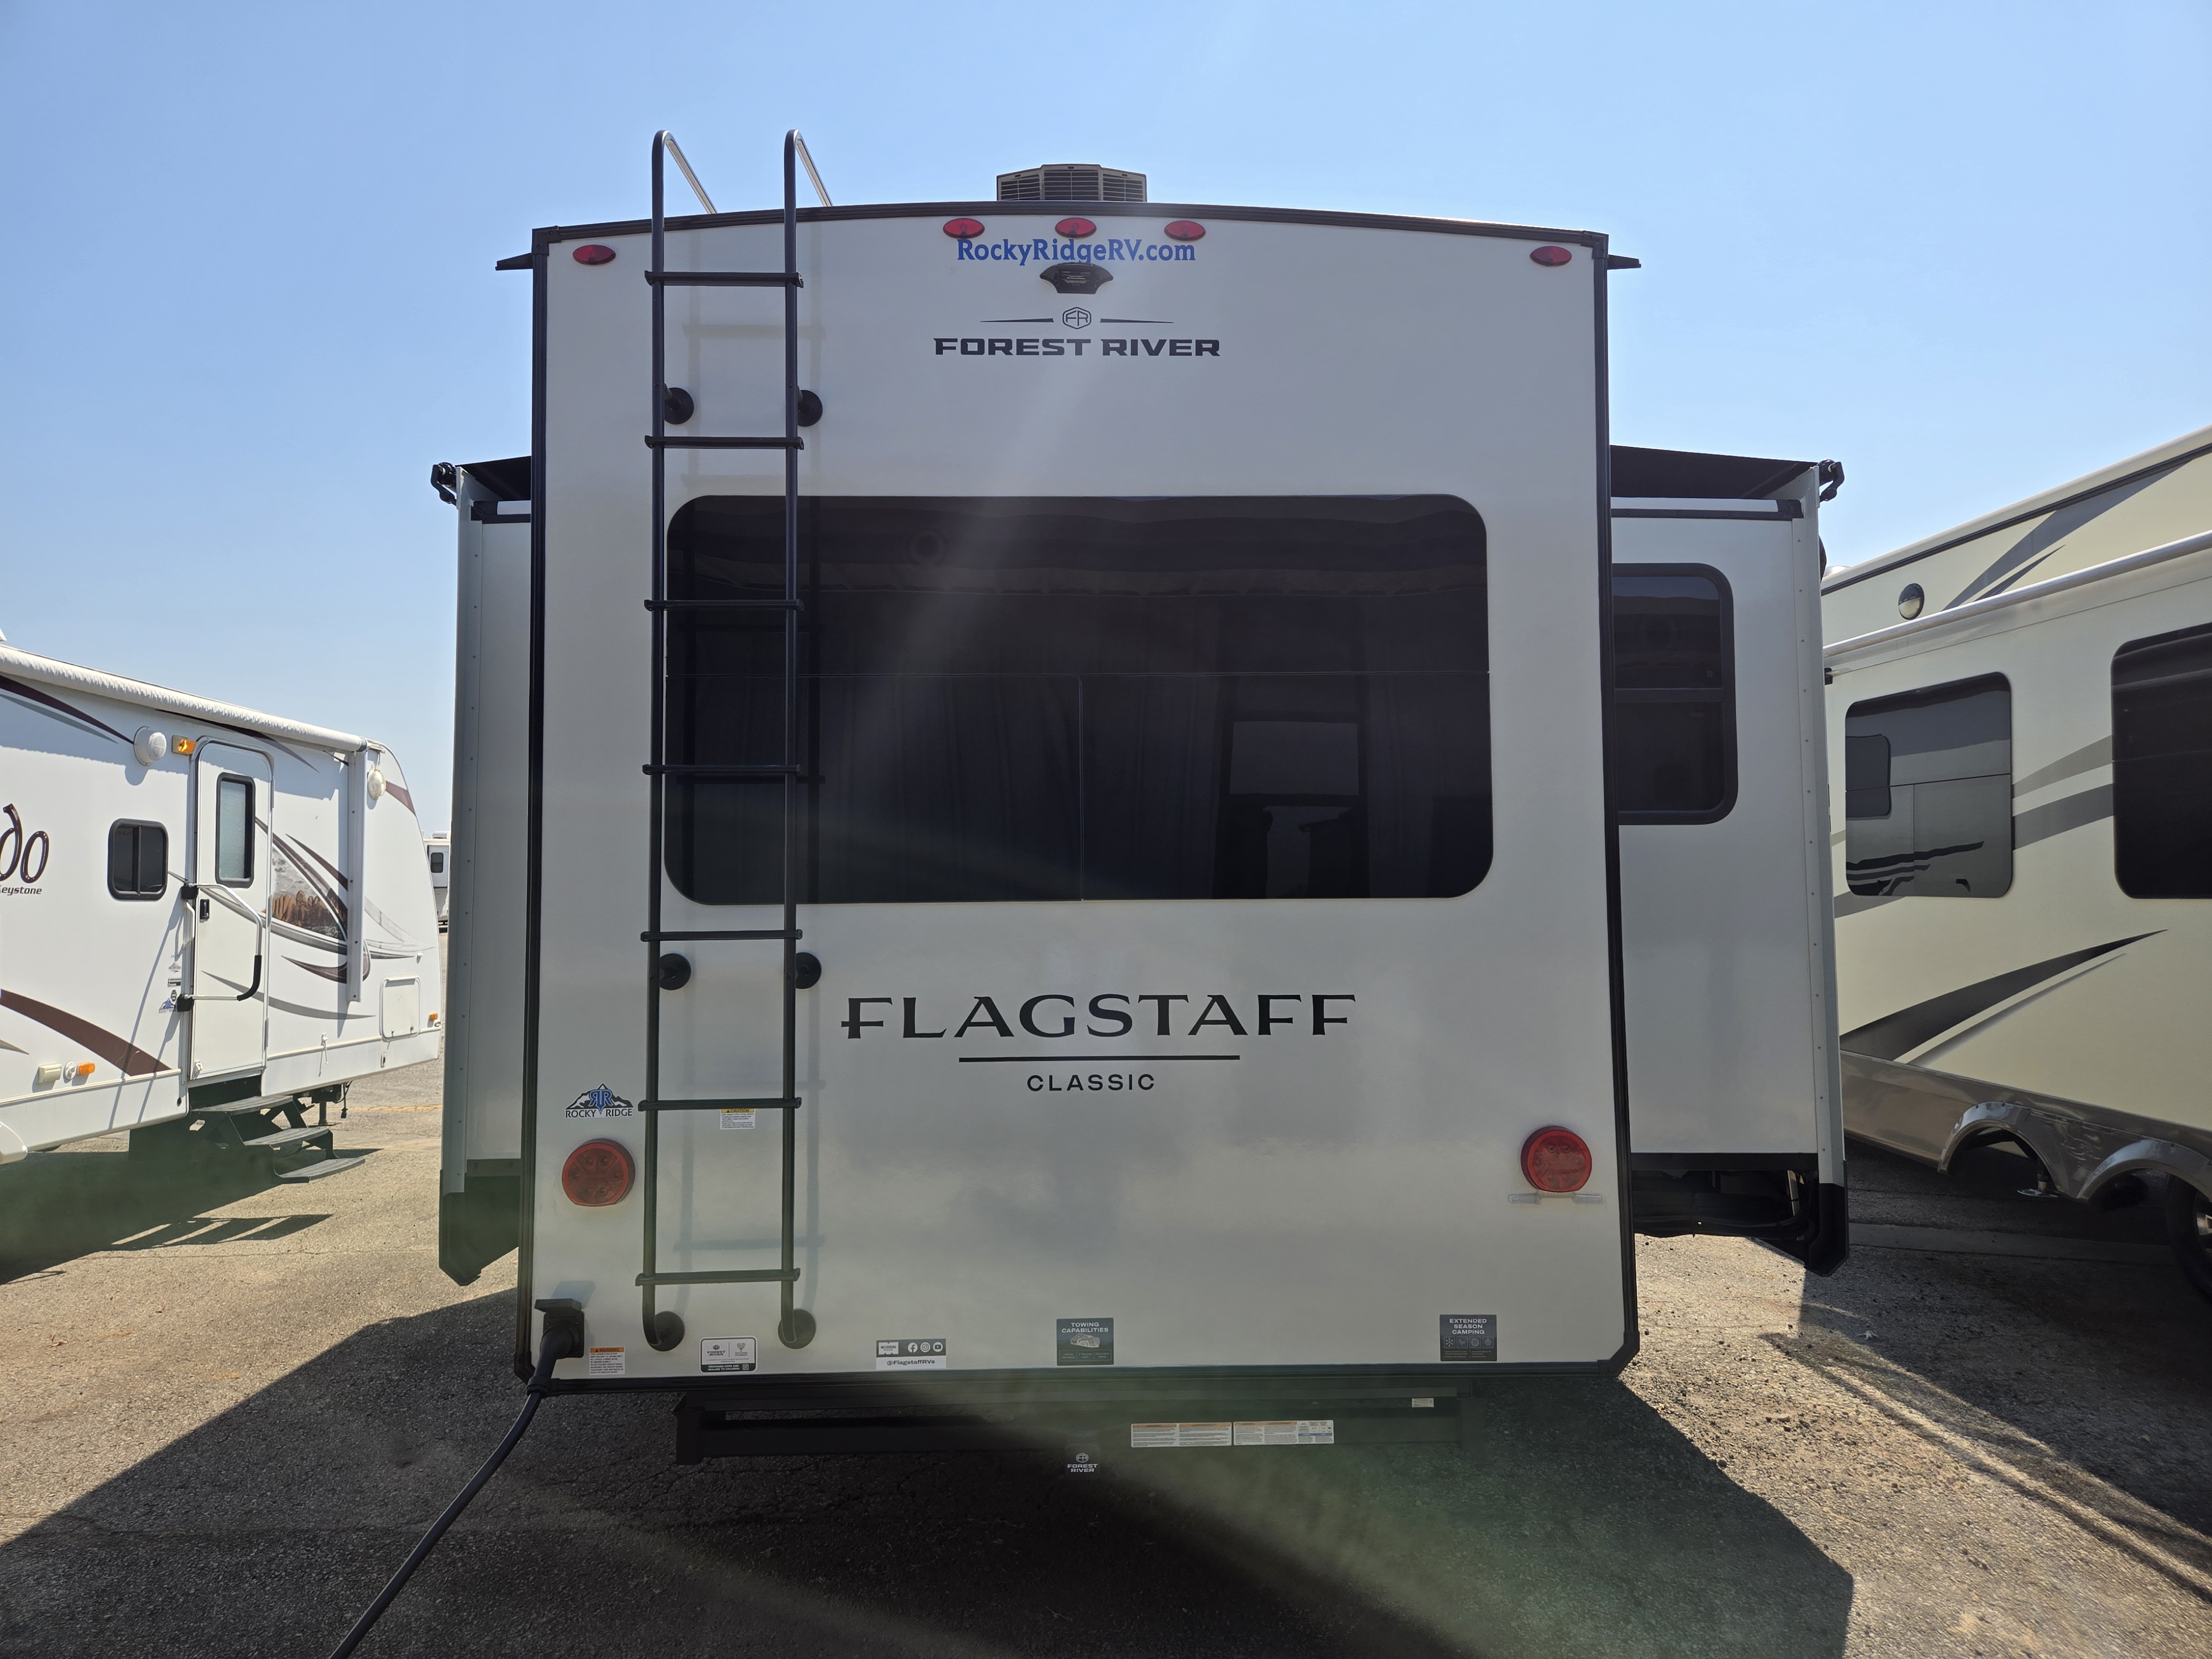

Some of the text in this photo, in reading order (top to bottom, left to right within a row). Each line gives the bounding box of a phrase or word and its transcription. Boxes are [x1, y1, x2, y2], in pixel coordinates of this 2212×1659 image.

[957, 238, 1196, 265] RockyRidgeRV.com
[933, 337, 1220, 357] FOREST RIVER
[0, 884, 42, 896] eystone
[841, 993, 1356, 1040] FLAGSTAFF
[1026, 1073, 1155, 1092] CLASSIC
[565, 1108, 633, 1118] ROCKY RIDGE
